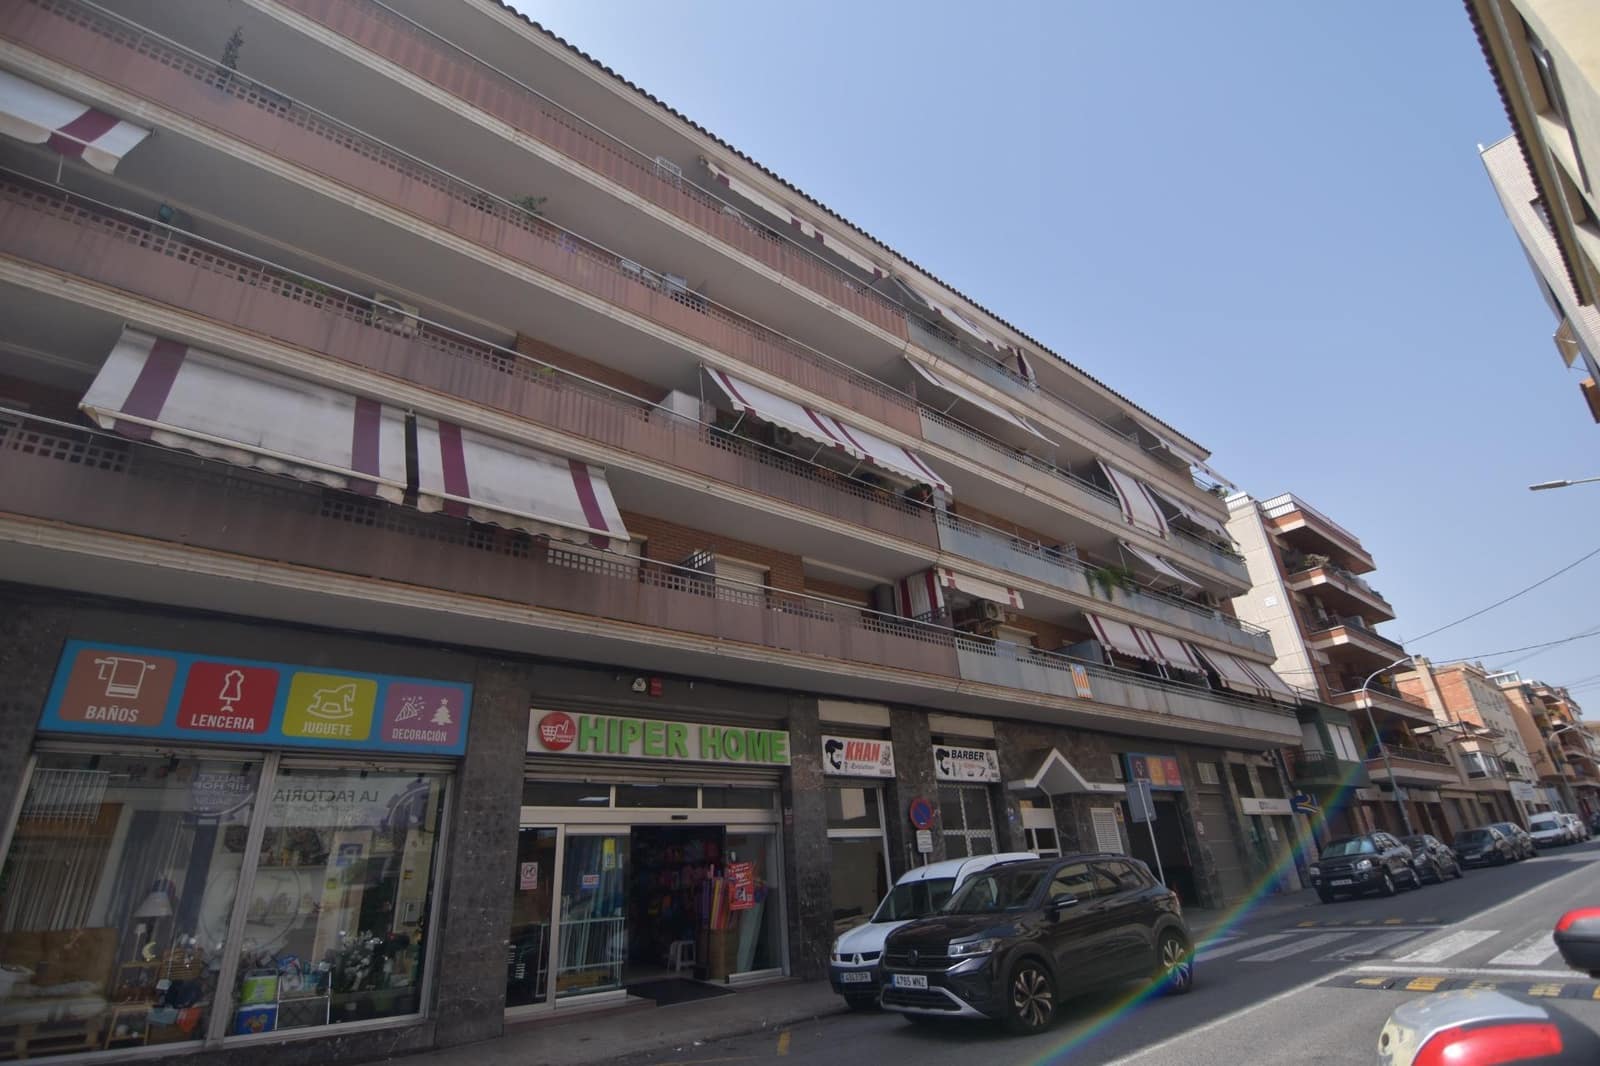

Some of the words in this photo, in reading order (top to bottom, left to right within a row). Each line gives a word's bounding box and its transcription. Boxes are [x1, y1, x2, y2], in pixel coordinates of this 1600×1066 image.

[85, 705, 139, 723] BAÑOS
[191, 713, 255, 730] LENCERIA
[302, 721, 352, 736] JUGUETE
[392, 727, 447, 742] DECORACIÓN
[578, 715, 689, 758] HIPER
[701, 726, 789, 764] HOME
[845, 741, 880, 762] KHAN
[951, 750, 984, 760] BARBER
